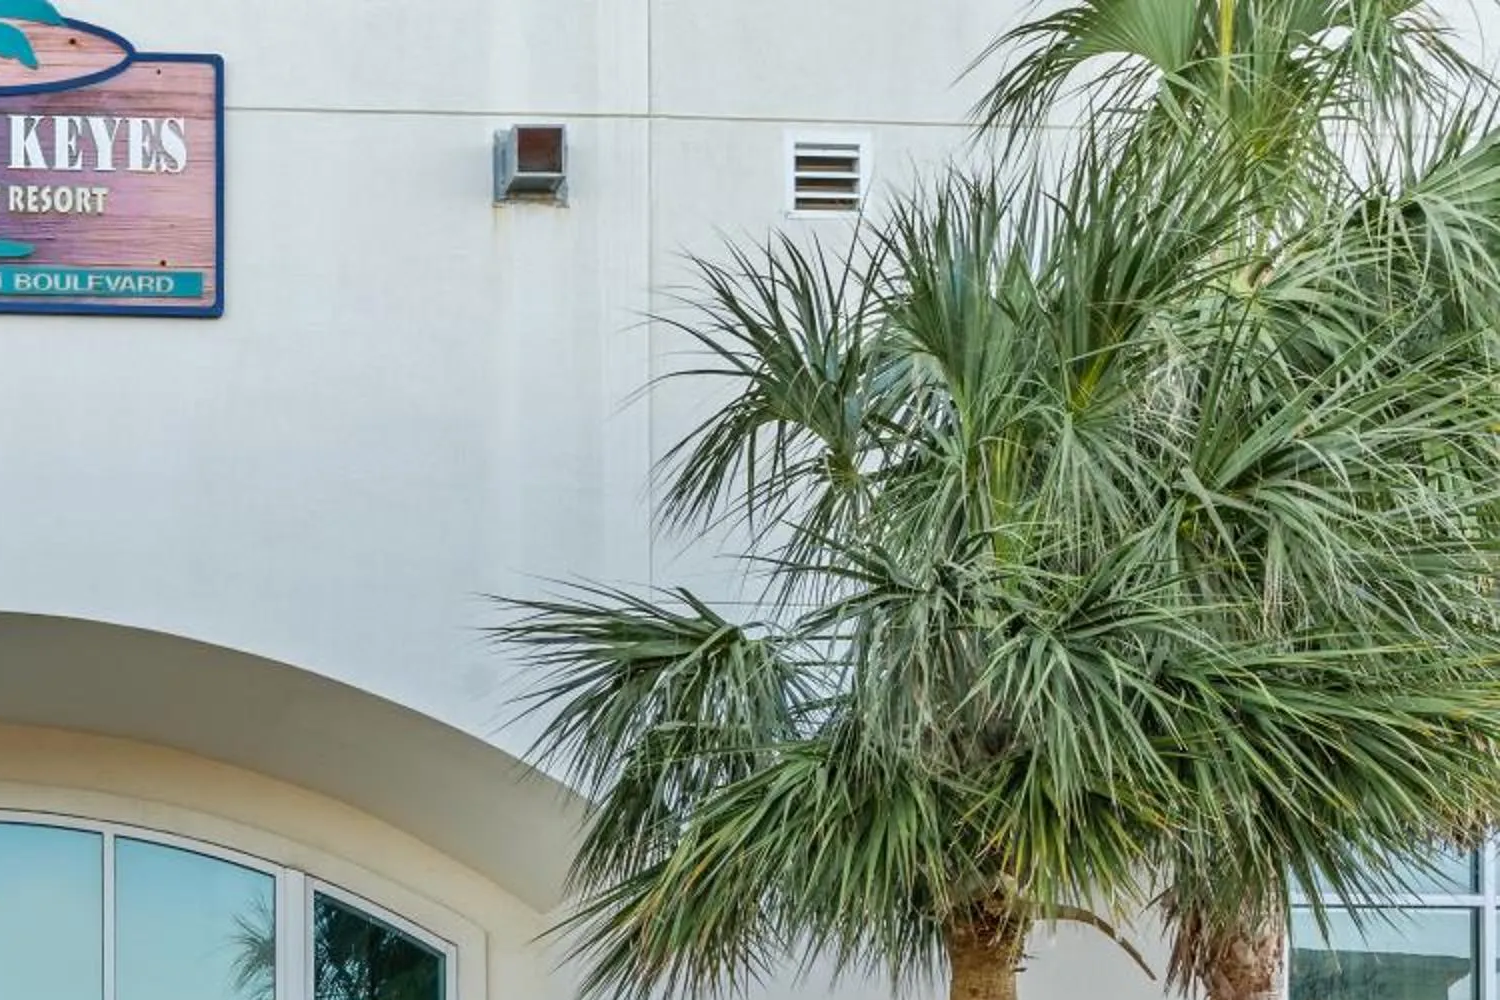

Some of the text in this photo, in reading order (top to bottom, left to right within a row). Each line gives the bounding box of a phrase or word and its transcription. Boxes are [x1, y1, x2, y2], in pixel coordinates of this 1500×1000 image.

[7, 115, 187, 173] KEYES
[8, 185, 108, 213] RESORT
[14, 272, 174, 293] BOULEVARD
